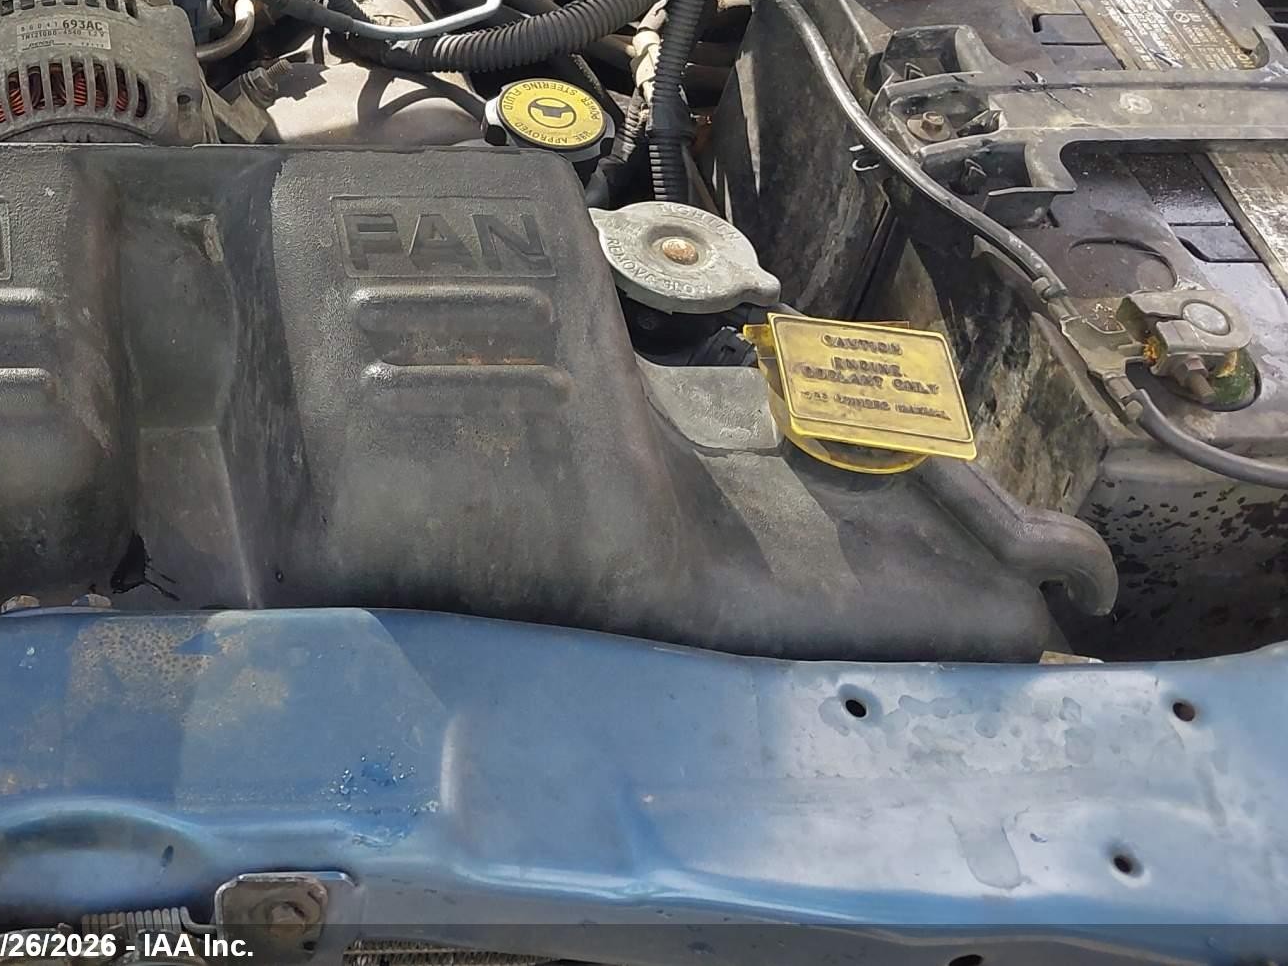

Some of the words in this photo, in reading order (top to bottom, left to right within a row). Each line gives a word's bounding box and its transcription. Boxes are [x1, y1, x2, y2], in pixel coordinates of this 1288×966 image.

[62, 19, 103, 31] 693AC
[522, 81, 578, 96] STEERING
[503, 89, 522, 110] FLUID
[514, 122, 568, 144] APPROVED
[341, 214, 552, 269] FAN
[821, 334, 903, 356] CAUTION
